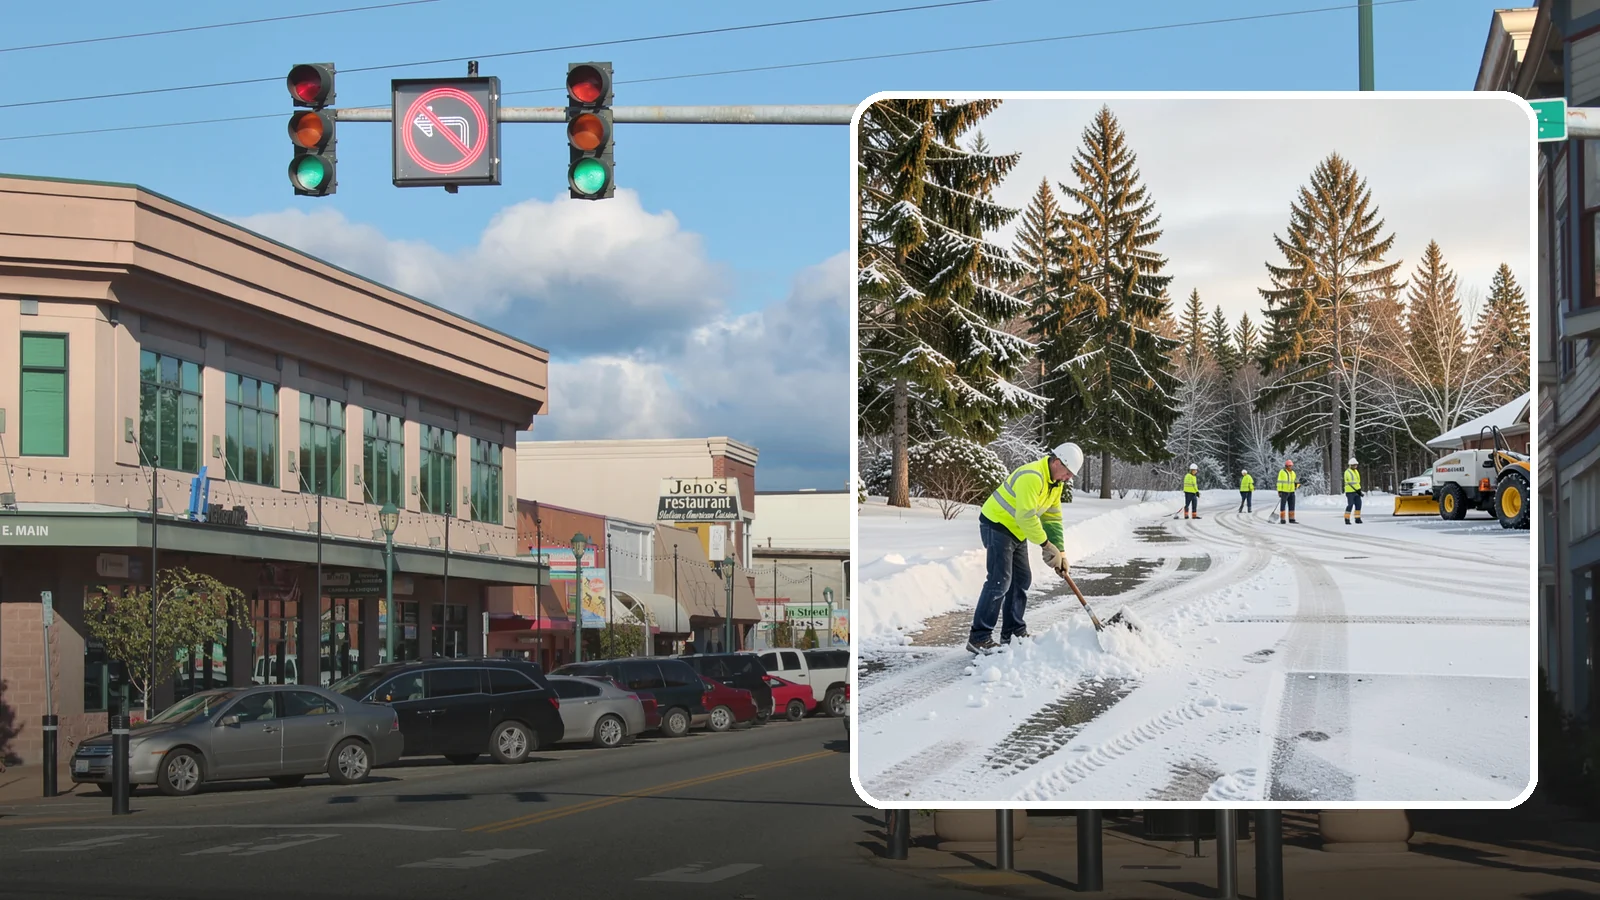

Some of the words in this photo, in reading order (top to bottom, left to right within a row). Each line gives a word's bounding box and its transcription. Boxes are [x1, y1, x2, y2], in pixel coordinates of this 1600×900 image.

[669, 480, 727, 494] Jeno's
[665, 496, 731, 509] restaurant
[658, 510, 681, 519] Italian
[686, 509, 715, 519] American
[715, 509, 737, 519] Cuisine
[2, 525, 13, 536] E.
[15, 525, 49, 536] MAIN
[797, 607, 829, 617] Street
